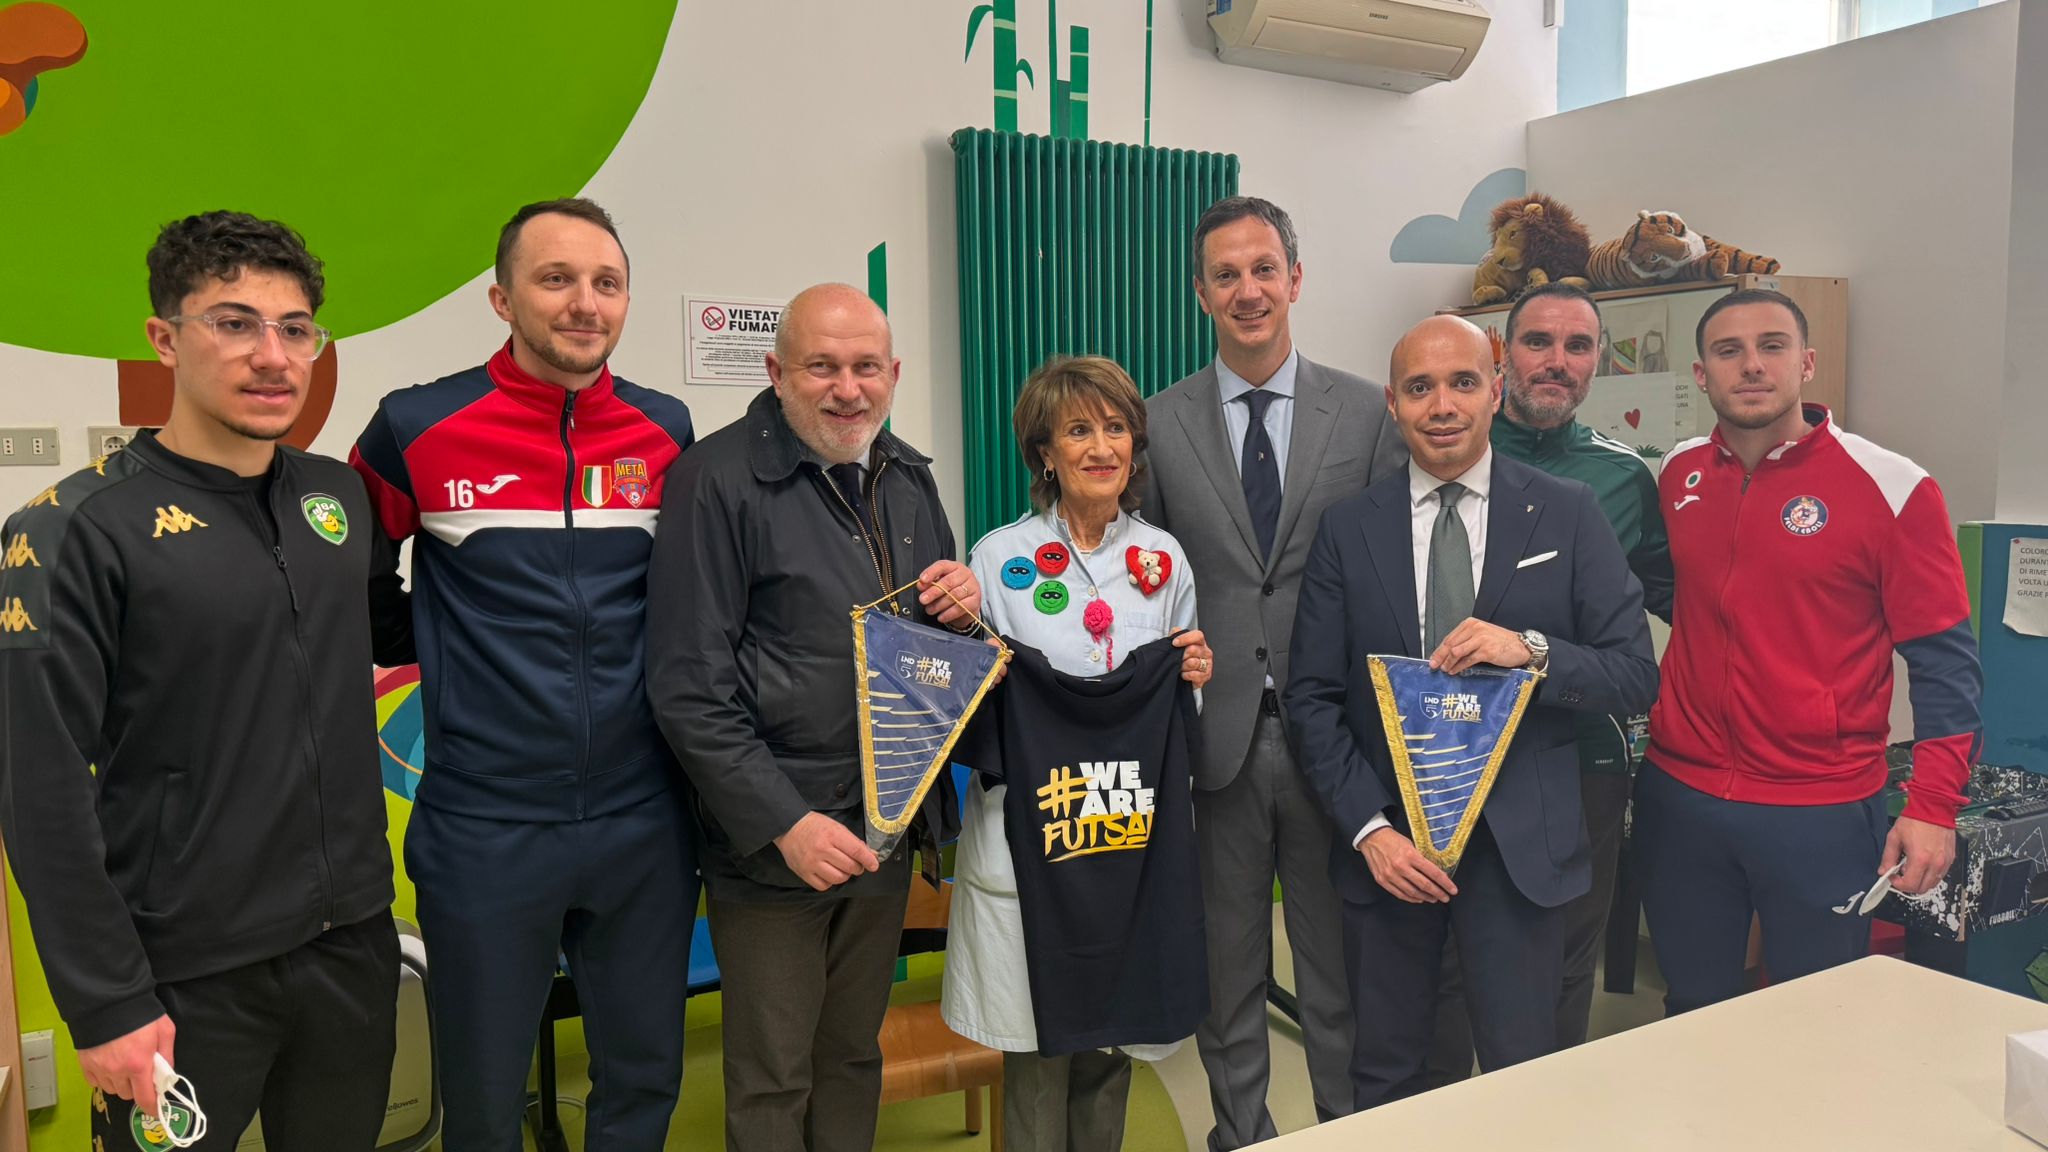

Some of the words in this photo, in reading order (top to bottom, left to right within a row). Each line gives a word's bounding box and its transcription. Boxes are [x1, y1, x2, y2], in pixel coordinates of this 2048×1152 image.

[728, 308, 780, 322] VIETAT
[616, 463, 645, 477] META
[443, 479, 474, 508] 16
[2019, 567, 2027, 575] DI
[2029, 568, 2048, 577] RIME
[2018, 577, 2042, 586] VOLTA
[2017, 589, 2044, 599] GRAZIE
[900, 655, 915, 665] LND
[928, 667, 952, 680] ARE
[1424, 696, 1440, 704] LND
[1455, 702, 1481, 713] ARE
[1079, 787, 1155, 818] ARE
